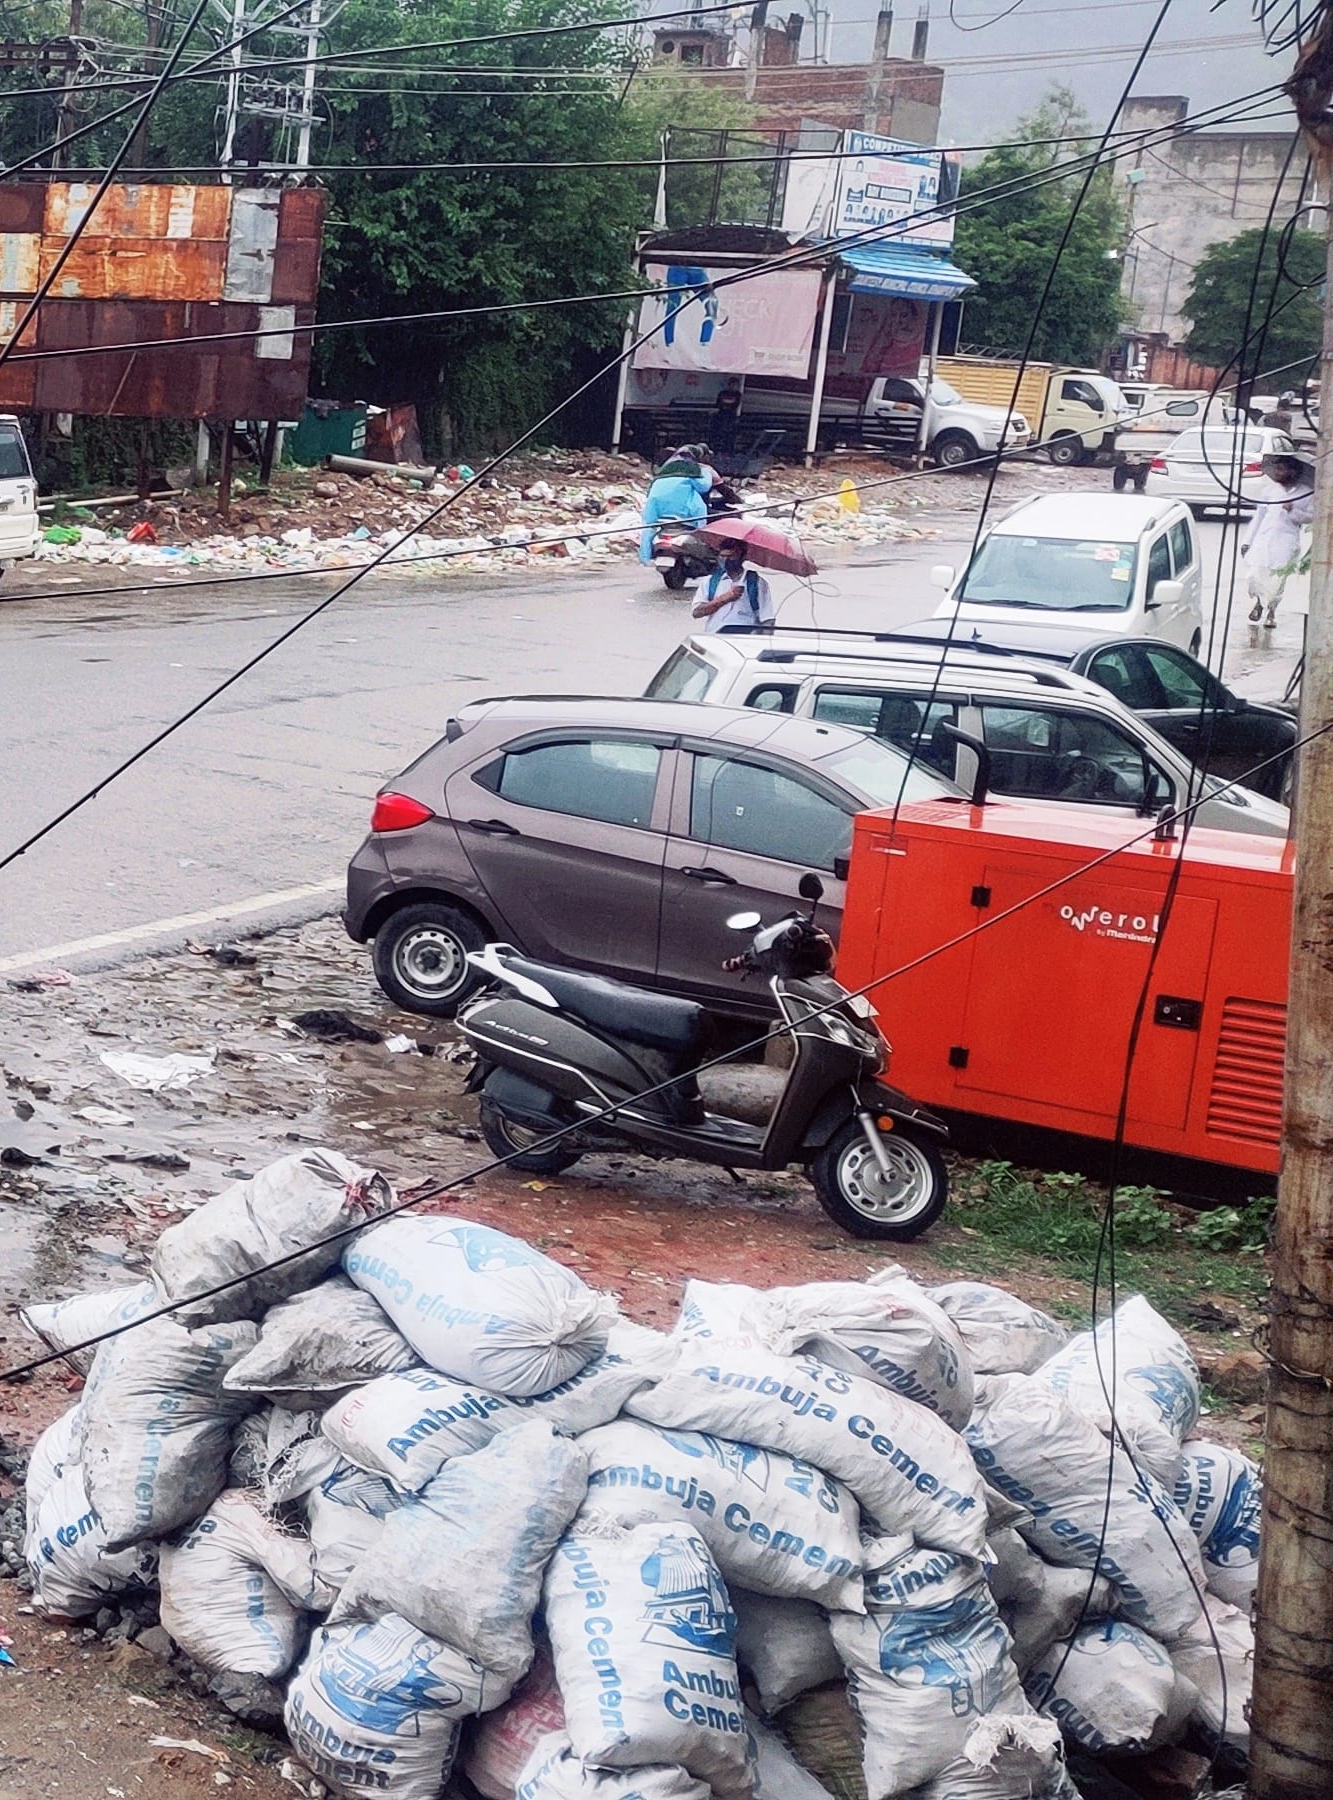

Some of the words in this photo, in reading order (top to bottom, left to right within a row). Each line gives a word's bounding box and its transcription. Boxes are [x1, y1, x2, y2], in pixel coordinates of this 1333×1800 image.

[342, 1252, 414, 1305] Ceme
[387, 1391, 508, 1462] Ambuja
[693, 1364, 838, 1423] Ambuja
[848, 1413, 977, 1517] Cement
